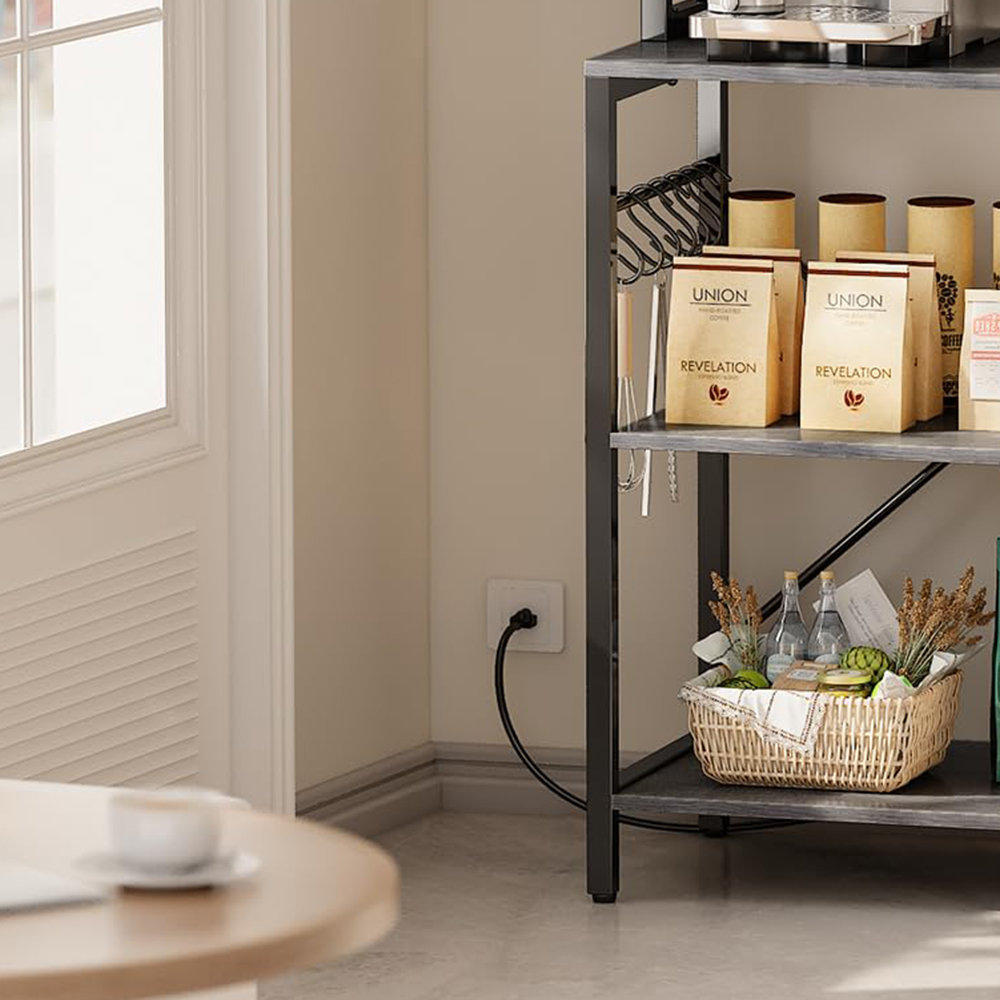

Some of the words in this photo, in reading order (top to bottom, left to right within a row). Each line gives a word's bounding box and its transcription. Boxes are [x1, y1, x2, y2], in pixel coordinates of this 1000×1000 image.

[693, 288, 748, 302] UNION
[828, 293, 883, 307] UNION
[681, 360, 757, 373] REVELATION
[816, 366, 892, 379] REVELATION
